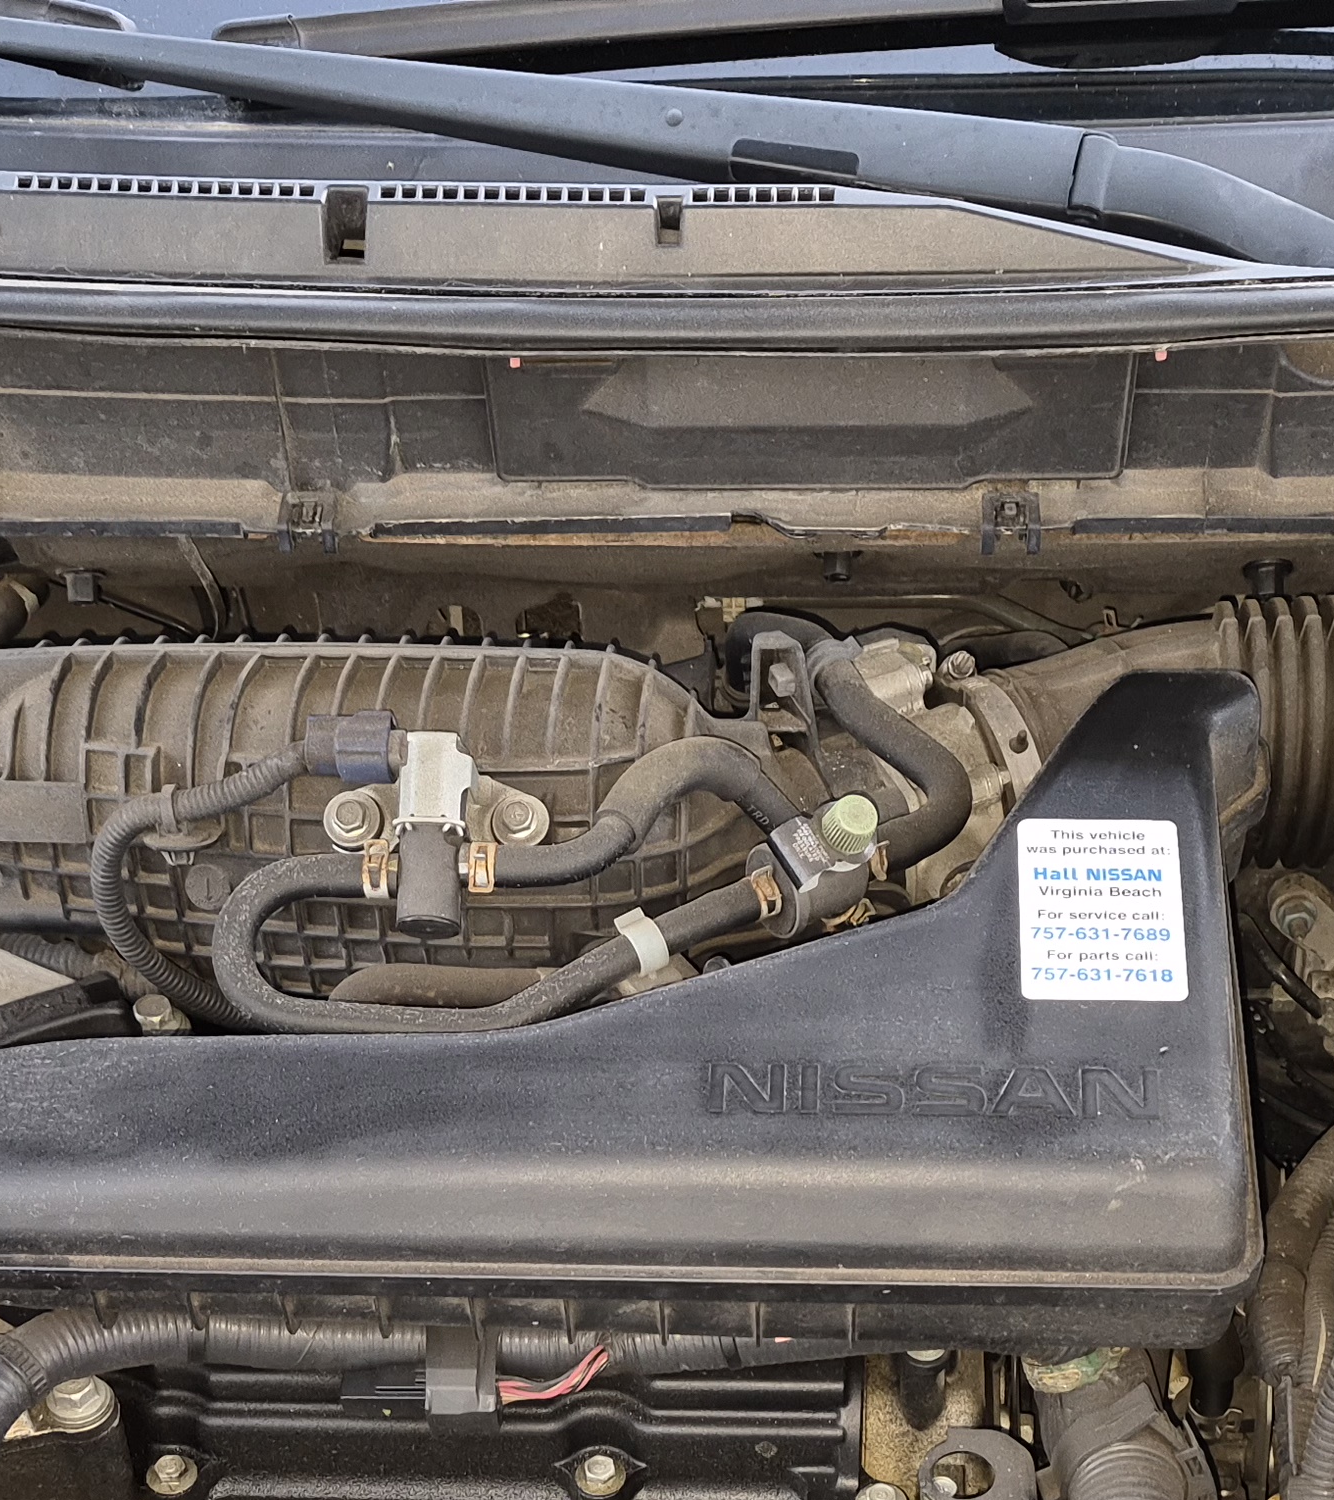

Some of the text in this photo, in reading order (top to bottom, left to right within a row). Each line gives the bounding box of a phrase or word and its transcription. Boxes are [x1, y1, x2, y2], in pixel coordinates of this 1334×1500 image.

[1051, 829, 1146, 841] This vehicle
[1026, 844, 1171, 856] was purchased at:
[1033, 867, 1163, 882] Hall NISSAN
[1038, 885, 1162, 899] Virginia Beach
[1037, 909, 1165, 922] For service call:
[1030, 926, 1171, 942] 757-631-7689
[1047, 950, 1159, 963] For parts call:
[1031, 967, 1174, 983] 757-631-7618
[708, 1061, 1161, 1119] NISSAN
